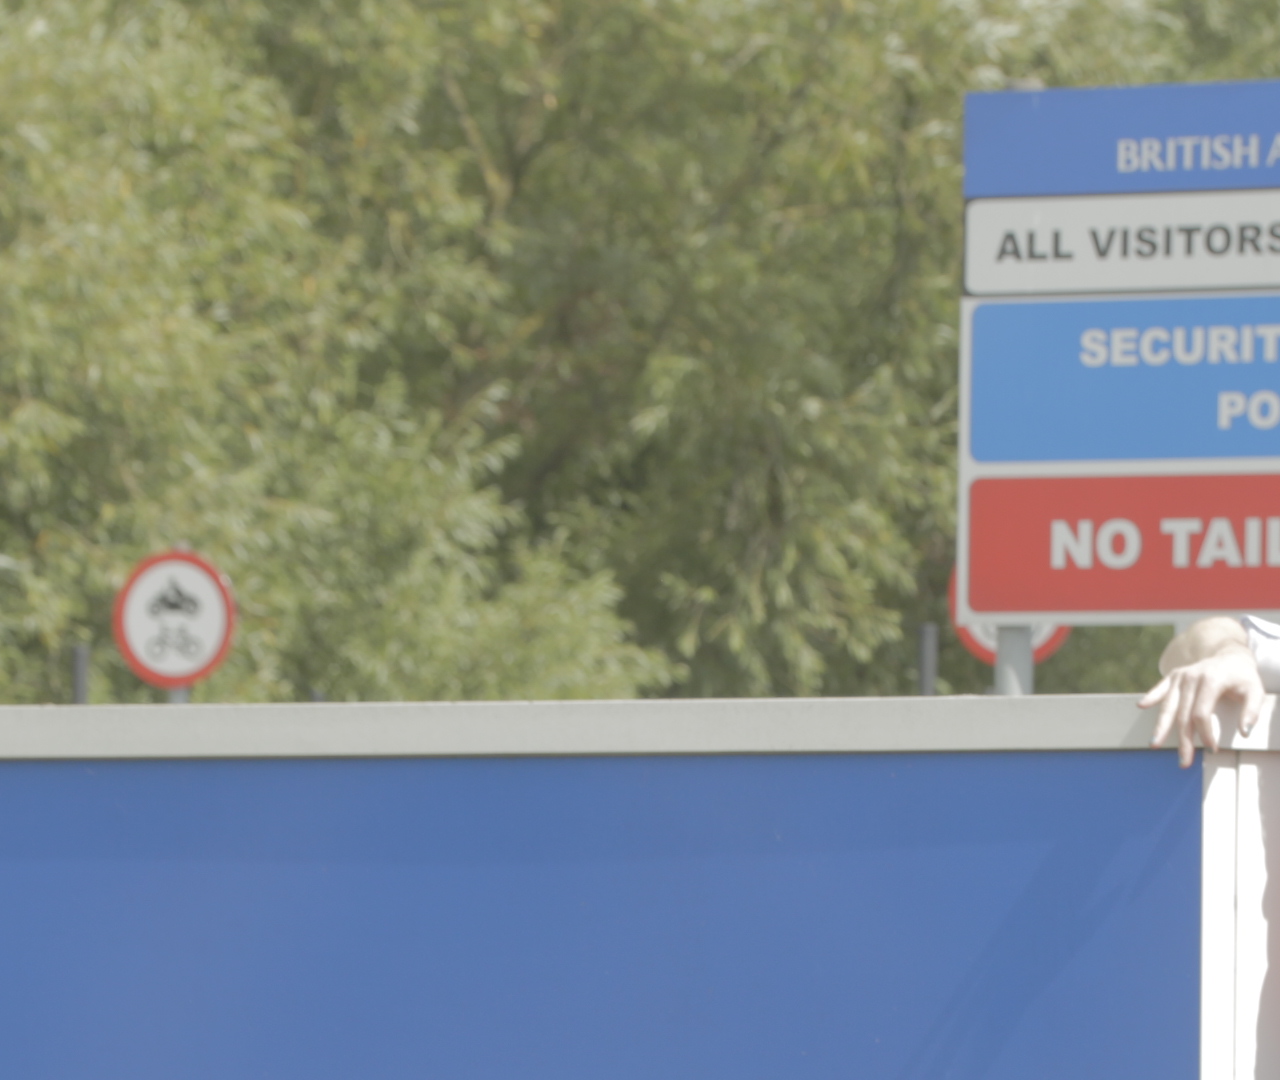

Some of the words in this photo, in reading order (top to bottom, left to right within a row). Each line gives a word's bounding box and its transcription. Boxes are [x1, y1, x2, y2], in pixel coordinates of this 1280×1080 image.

[1116, 134, 1260, 173] BRITISH
[996, 230, 1073, 261] ALL
[1050, 518, 1142, 569] NO
